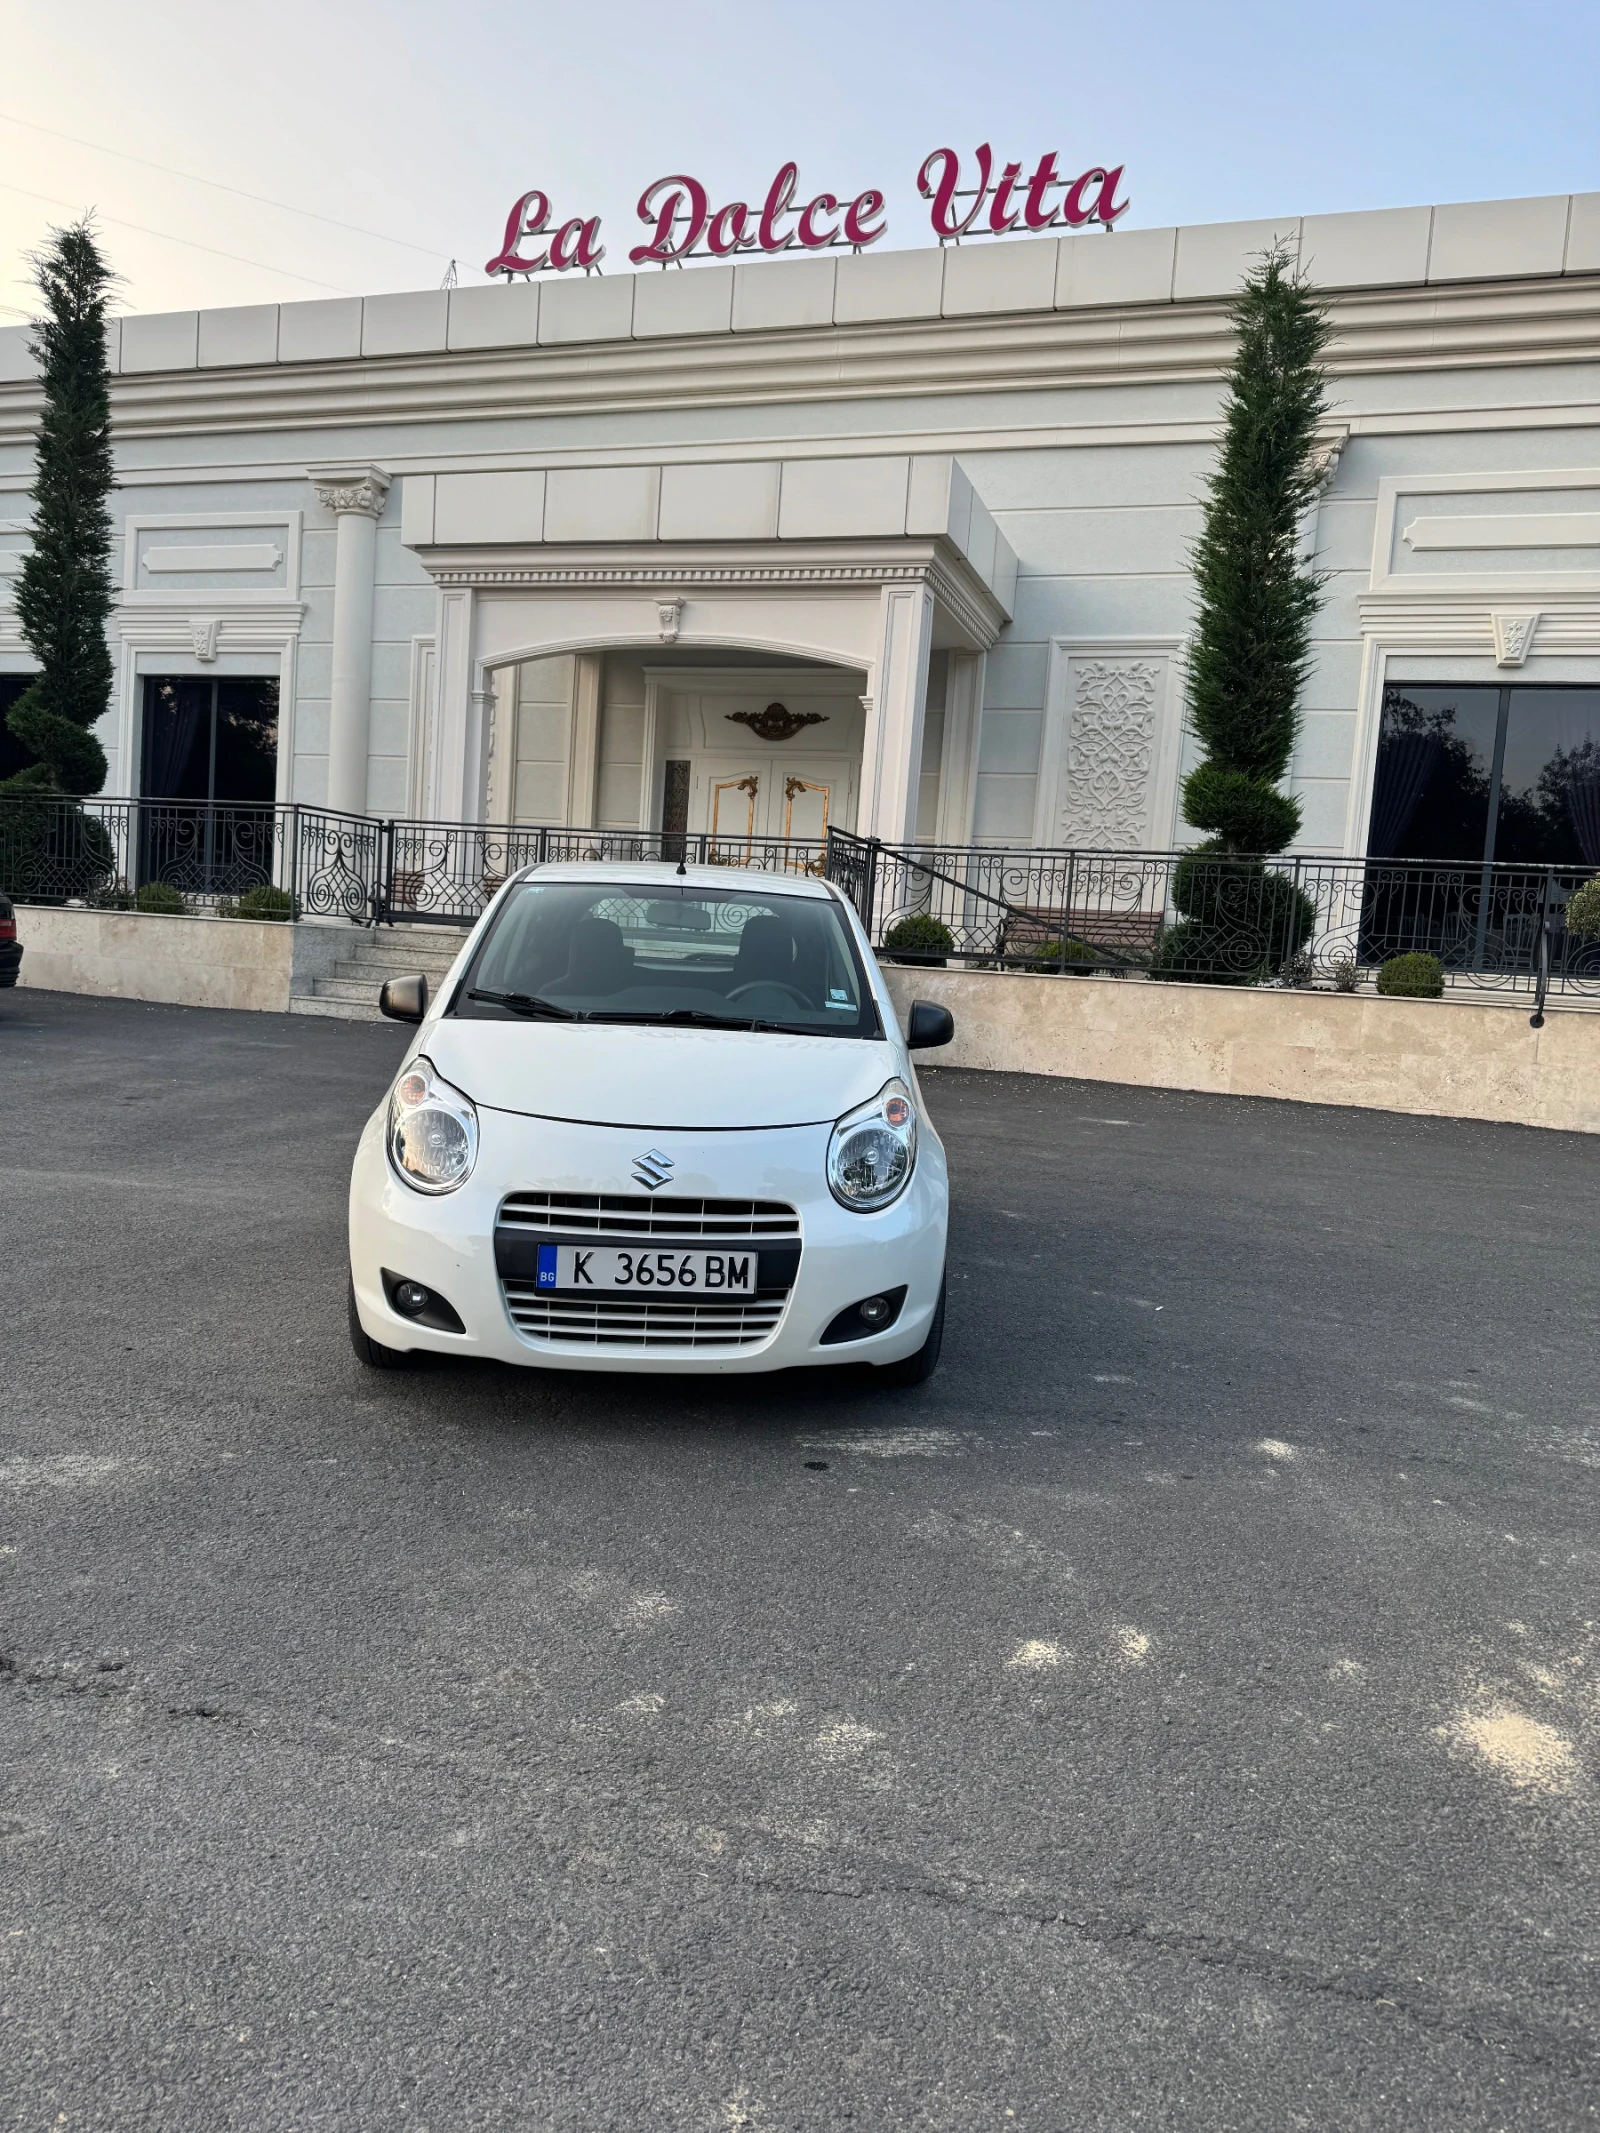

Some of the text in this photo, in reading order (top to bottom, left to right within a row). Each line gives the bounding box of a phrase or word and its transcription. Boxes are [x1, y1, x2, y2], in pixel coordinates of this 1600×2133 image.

[485, 142, 1131, 277] La Dolce Vita
[540, 1251, 750, 1289] BG K 3656 BM
